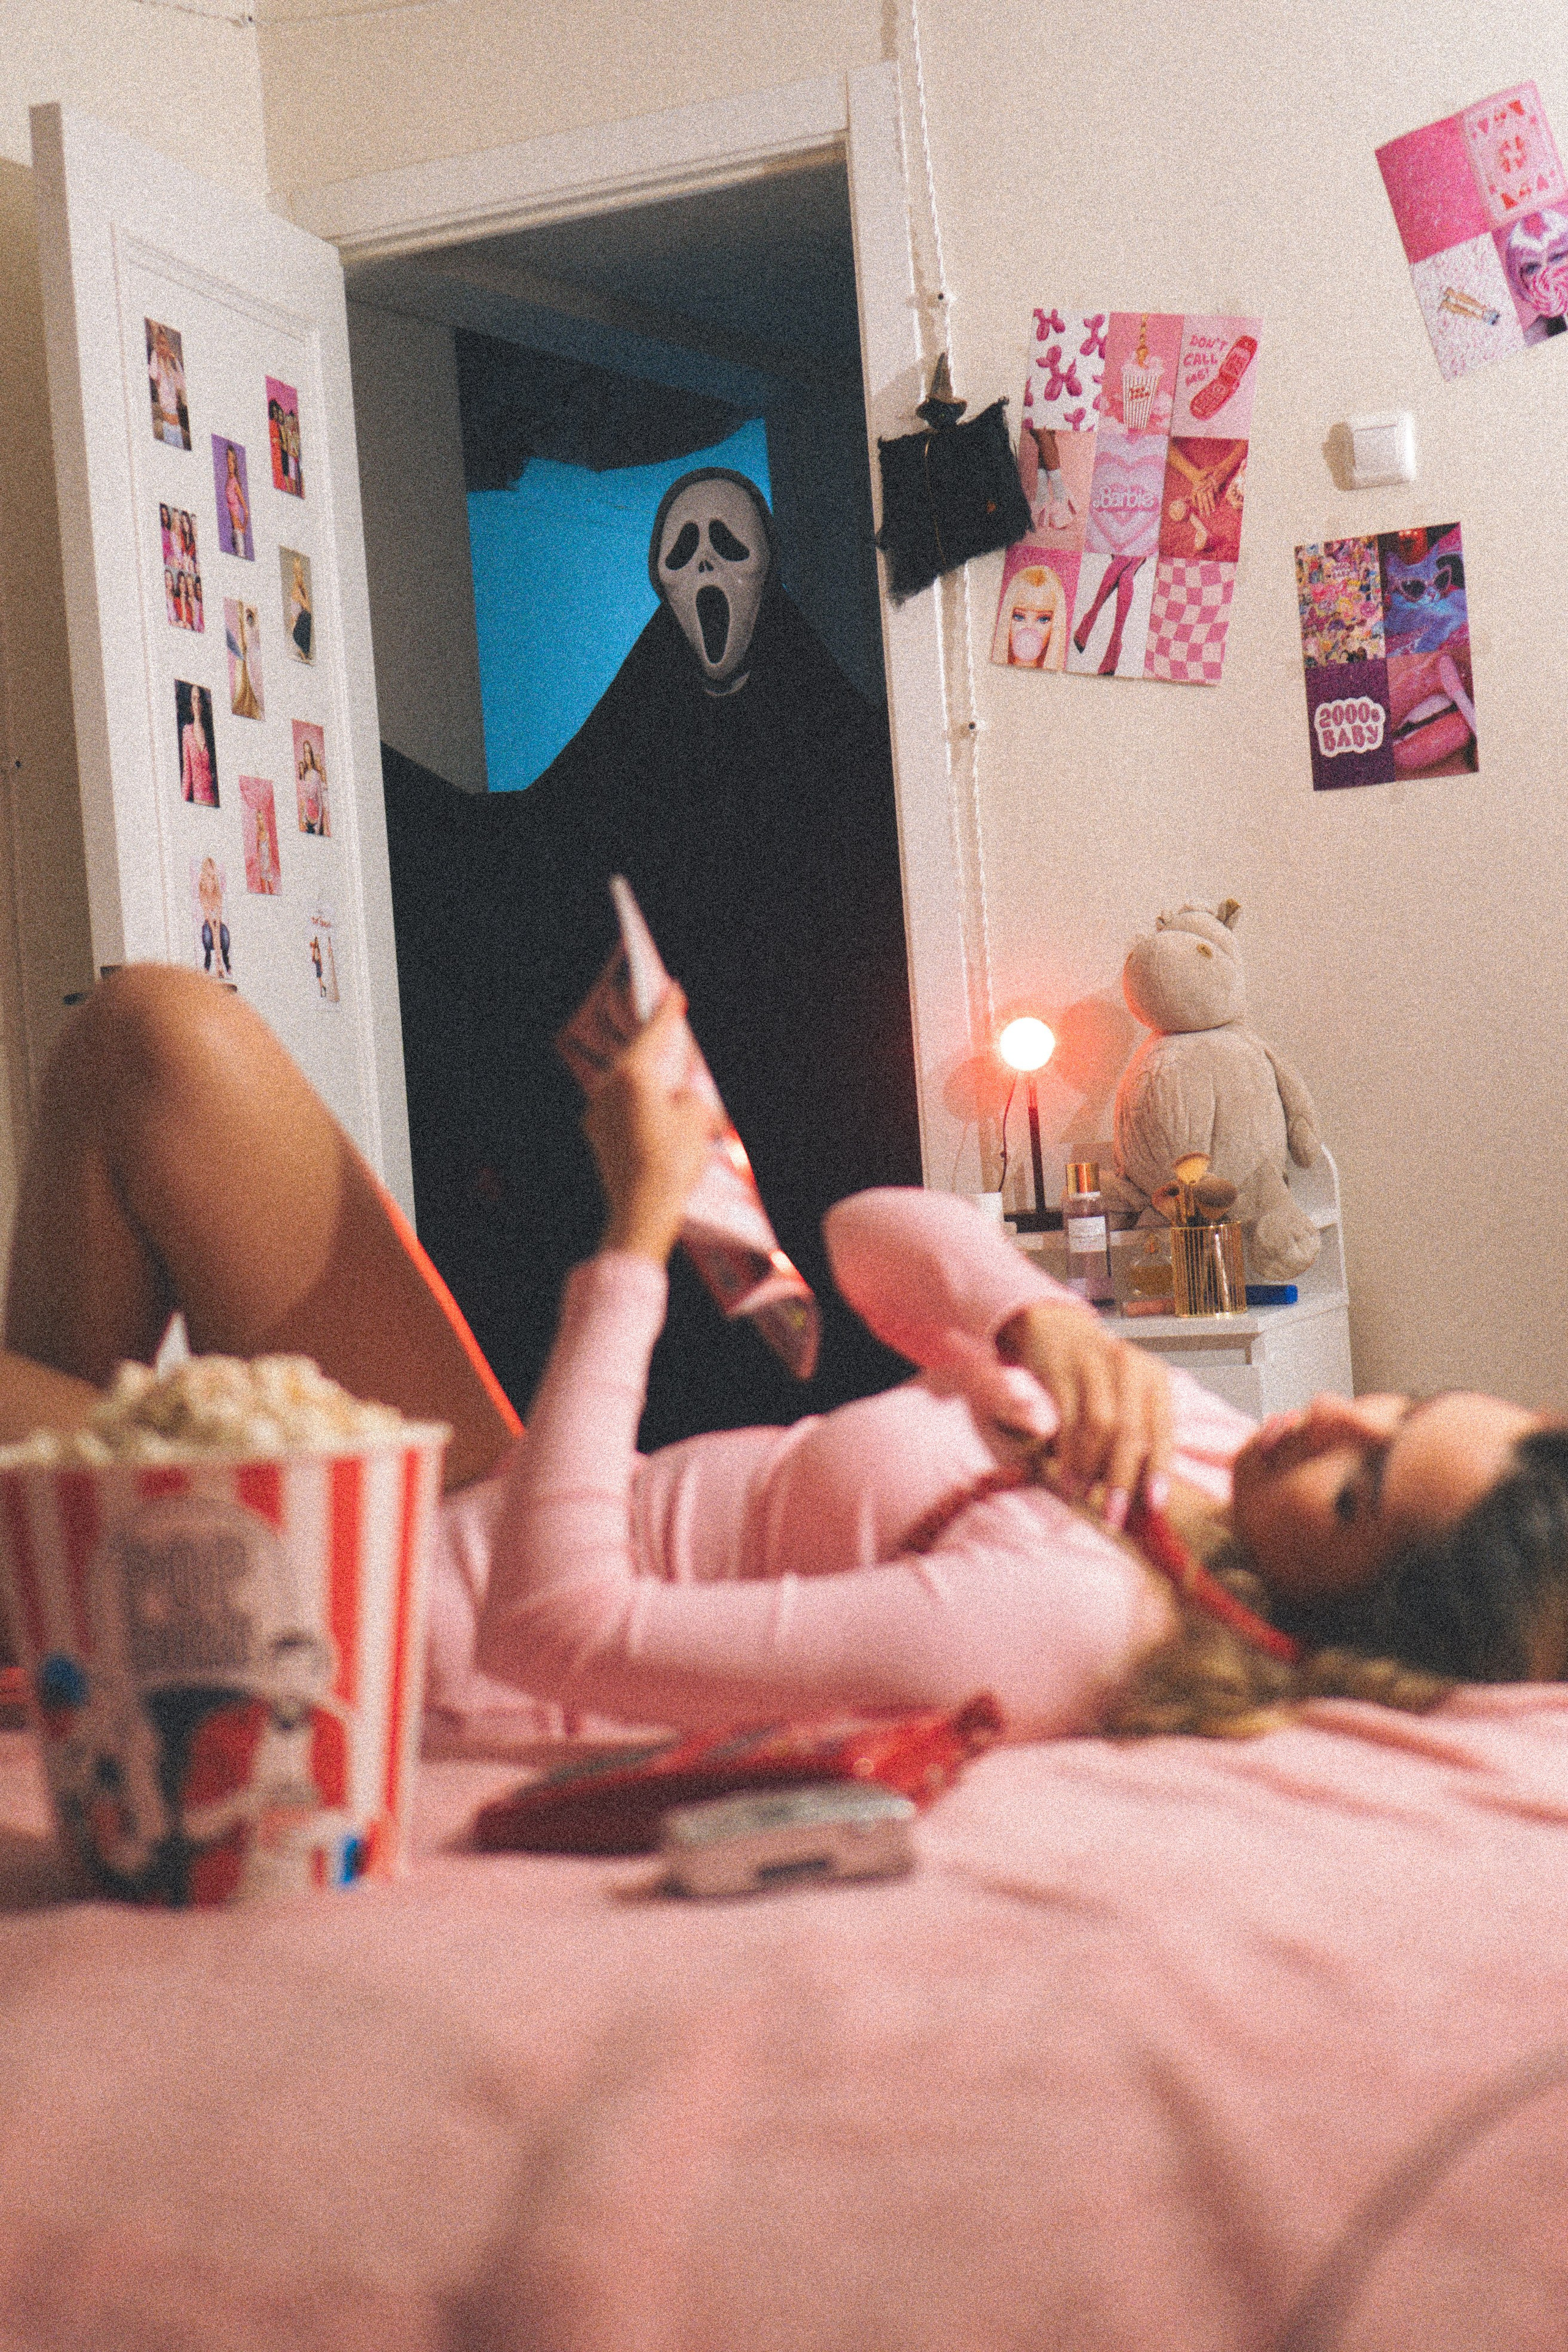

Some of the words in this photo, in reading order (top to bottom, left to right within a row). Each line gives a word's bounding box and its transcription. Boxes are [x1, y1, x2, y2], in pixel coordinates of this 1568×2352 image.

[1189, 334, 1228, 351] DON'T
[1183, 353, 1218, 367] CALL
[1185, 367, 1210, 387] ME!
[1093, 482, 1155, 508] Barbie
[1319, 701, 1381, 728] 2000s
[1322, 723, 1379, 752] BABY
